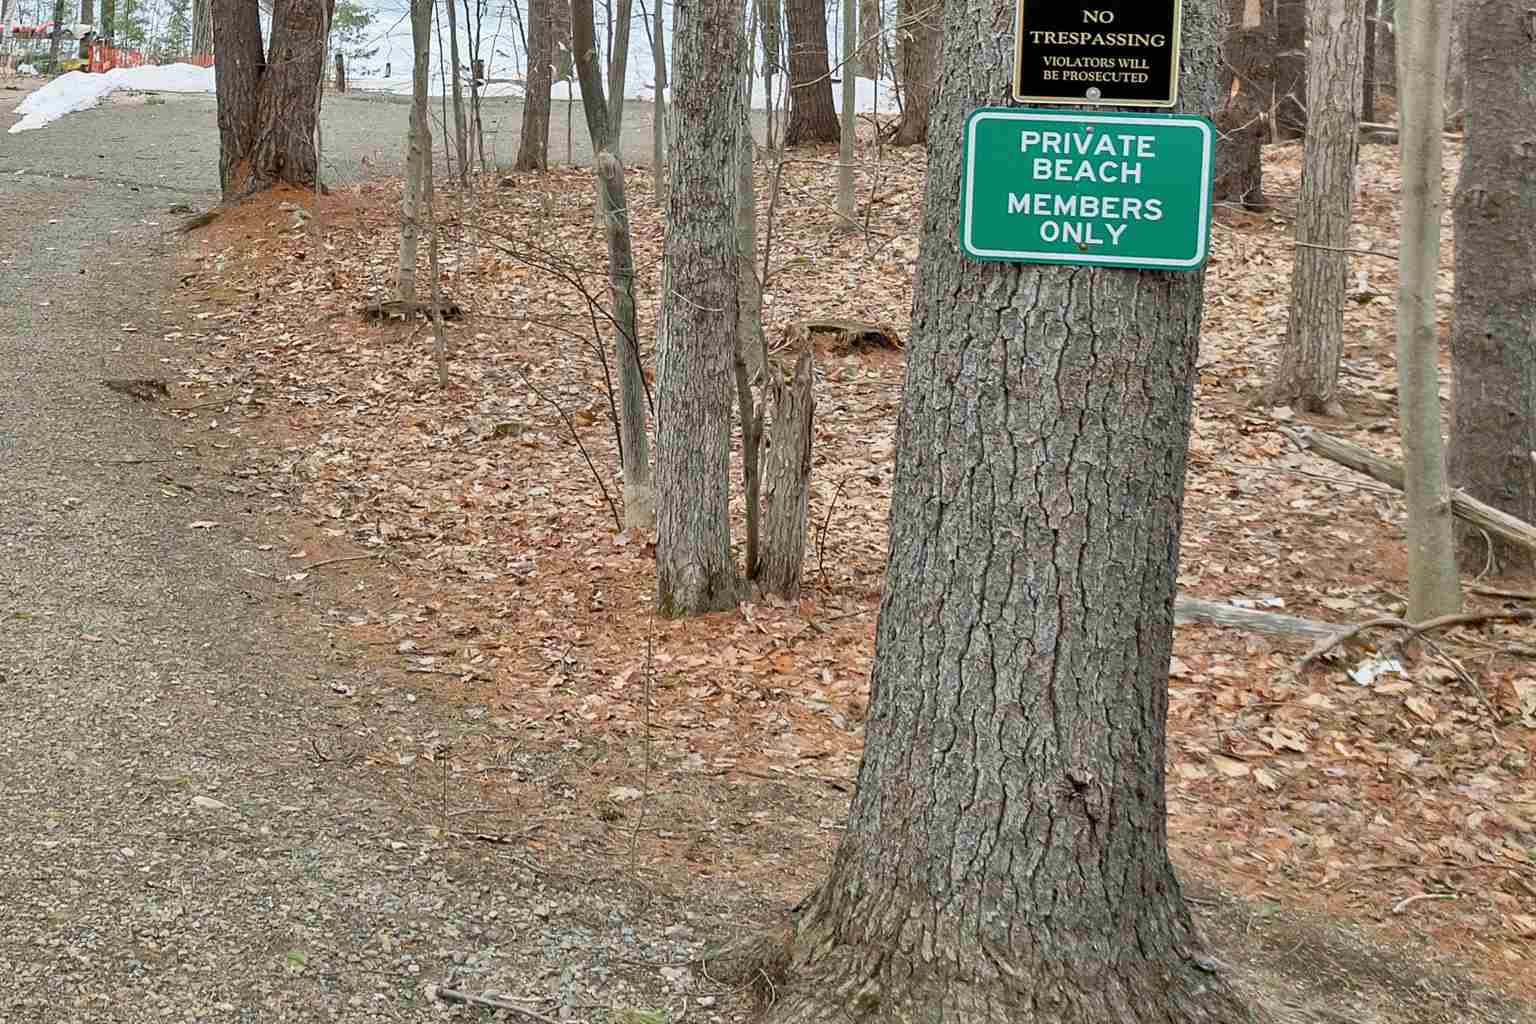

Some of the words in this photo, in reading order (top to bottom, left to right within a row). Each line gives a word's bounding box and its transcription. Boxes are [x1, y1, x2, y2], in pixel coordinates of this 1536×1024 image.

[1082, 10, 1114, 24] NO
[1029, 31, 1166, 48] TRESPASSING
[1043, 56, 1115, 69] VIOLATORS
[1118, 58, 1150, 70] WILL
[1043, 70, 1059, 81] BE
[1062, 71, 1149, 83] PROSECUTED
[1020, 130, 1156, 158] PRIVATE
[1032, 158, 1142, 184] BEACH
[1007, 192, 1163, 221] MEMBERS
[1039, 221, 1127, 246] ONLY
